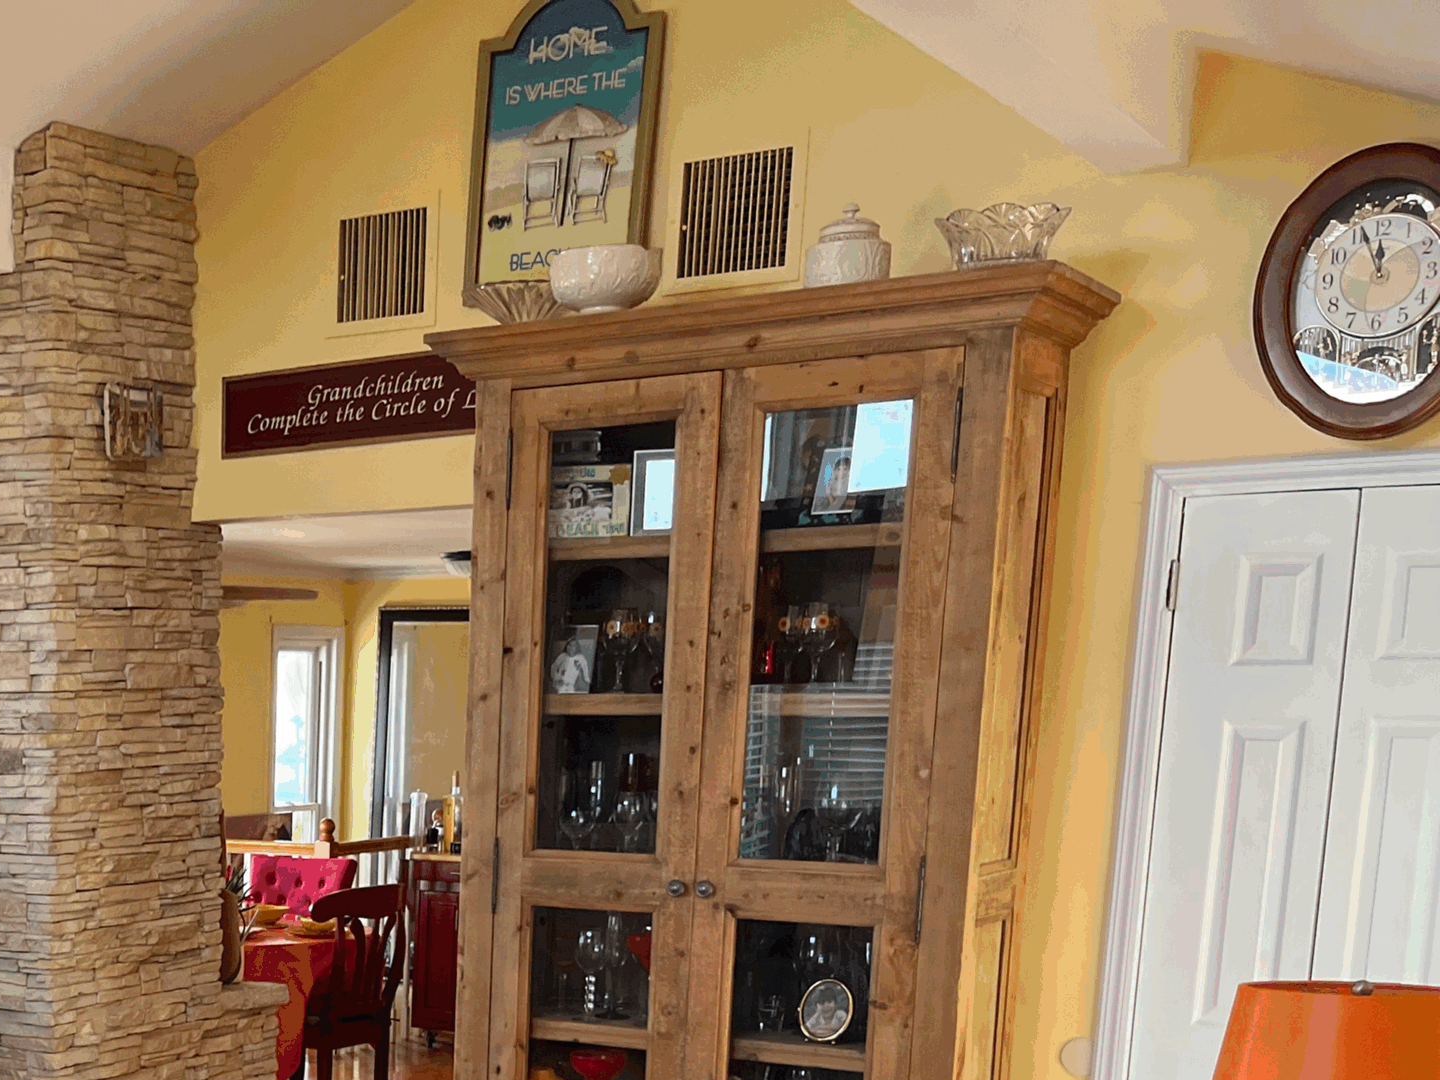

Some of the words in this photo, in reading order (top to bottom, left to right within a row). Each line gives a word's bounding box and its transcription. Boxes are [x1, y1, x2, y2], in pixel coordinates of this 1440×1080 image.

[528, 26, 608, 65] HOME
[505, 86, 520, 105] IS
[524, 75, 588, 102] WHERE
[592, 68, 627, 91] THE
[1374, 219, 1392, 237] 12
[1422, 237, 1433, 255] 2
[510, 248, 561, 272] BEAC
[1331, 247, 1347, 265] 10
[1426, 261, 1437, 280] 3
[1322, 273, 1333, 290] 9
[1327, 296, 1339, 314] 8
[1414, 287, 1428, 306] 4
[1345, 312, 1357, 329] 7
[1371, 313, 1382, 331] 6
[1397, 306, 1409, 324] 5
[307, 370, 445, 410] Grandchildren
[247, 407, 328, 435] Complete
[335, 401, 365, 423] the
[371, 391, 427, 421] Circle
[433, 388, 460, 418] of
